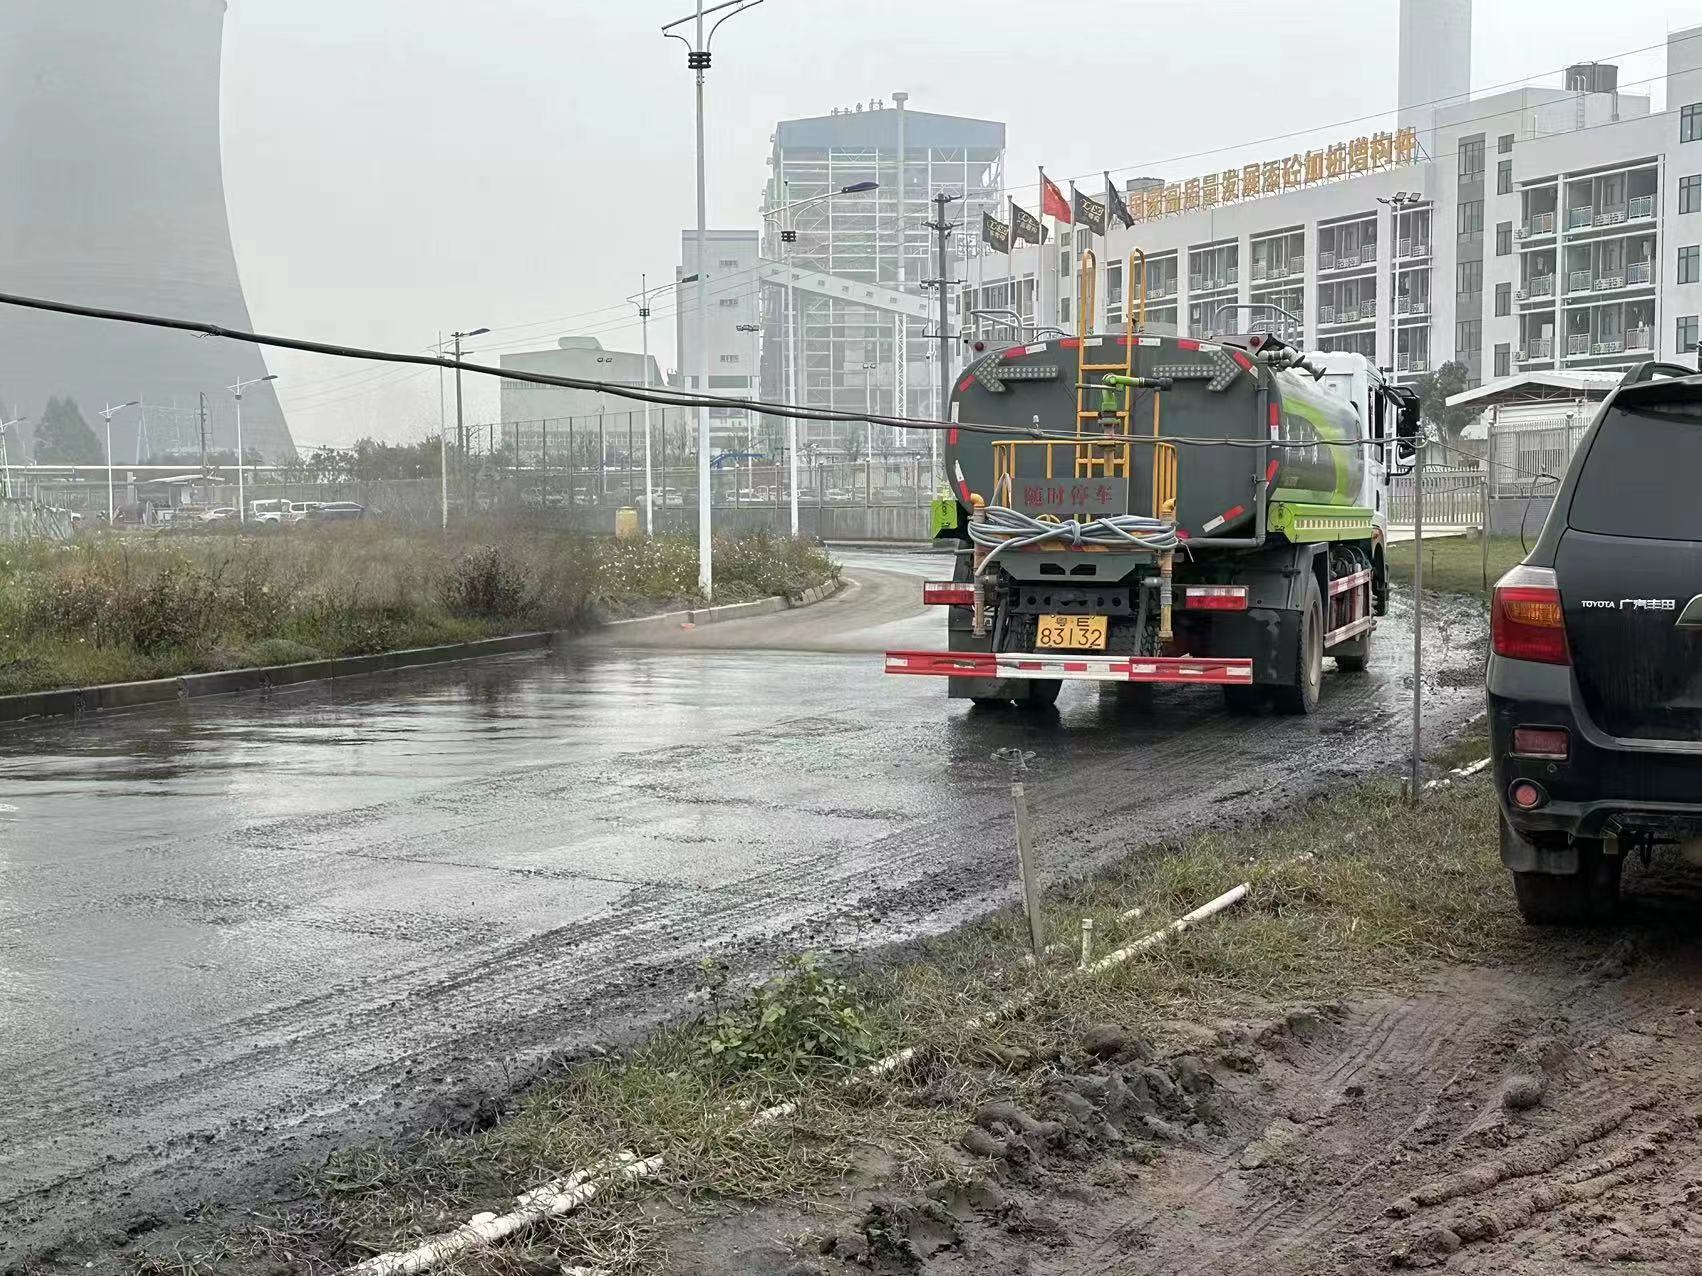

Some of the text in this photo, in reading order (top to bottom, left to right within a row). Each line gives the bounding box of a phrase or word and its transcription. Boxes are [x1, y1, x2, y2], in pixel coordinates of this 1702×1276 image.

[1024, 485, 1112, 507] 随时停车
[1581, 598, 1675, 610] TOYOTA 广汽丰田
[1040, 627, 1102, 646] 83132
